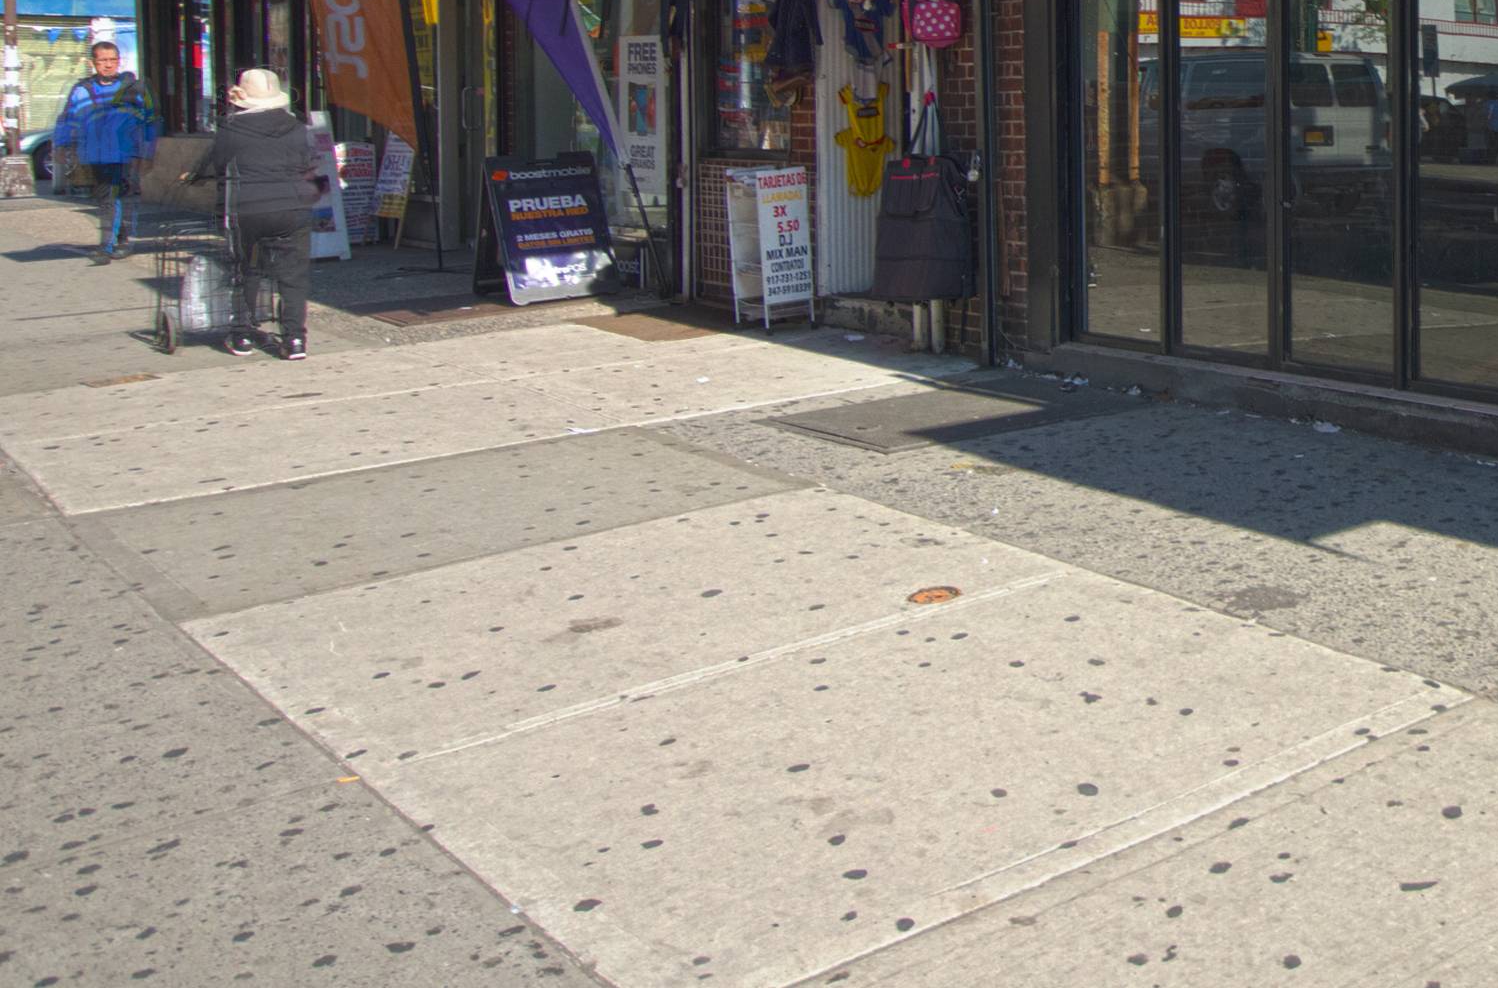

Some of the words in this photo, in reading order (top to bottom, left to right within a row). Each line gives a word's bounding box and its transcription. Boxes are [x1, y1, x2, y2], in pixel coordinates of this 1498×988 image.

[628, 43, 656, 61] FREE
[628, 62, 656, 75] PHONES
[630, 146, 655, 159] GREAT
[757, 173, 795, 190] TARJETAS
[796, 172, 808, 185] DE
[508, 194, 588, 212] PRUEBA
[773, 205, 787, 217] 3X
[777, 220, 799, 233] 5.50
[524, 231, 558, 242] MESES
[559, 228, 594, 240] GRATIS
[766, 248, 784, 260] MIX
[786, 246, 807, 259] MAN
